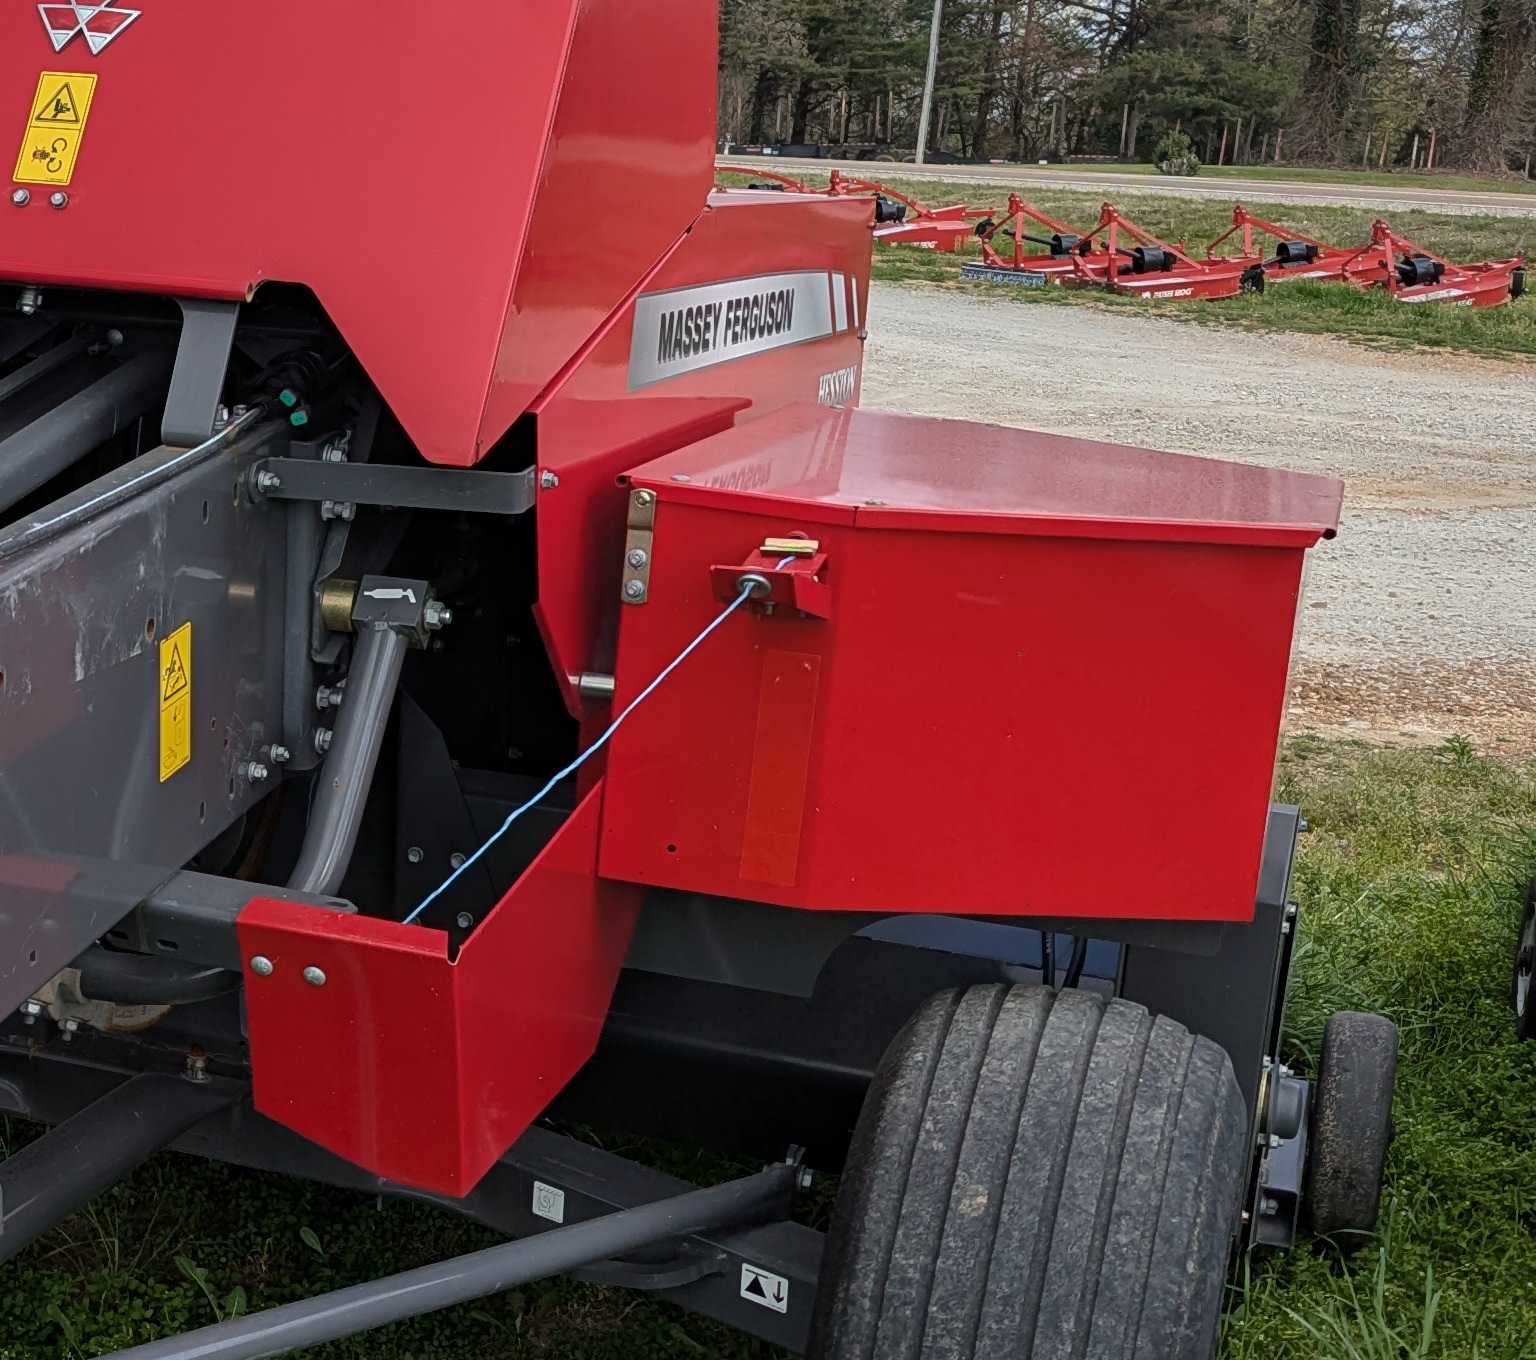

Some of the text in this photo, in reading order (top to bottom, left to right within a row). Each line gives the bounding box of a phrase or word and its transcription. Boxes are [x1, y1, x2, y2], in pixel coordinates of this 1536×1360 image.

[1174, 287, 1192, 297] HOG
[657, 288, 795, 364] MASSEY FERGUSON
[817, 364, 858, 405] HESSTON
